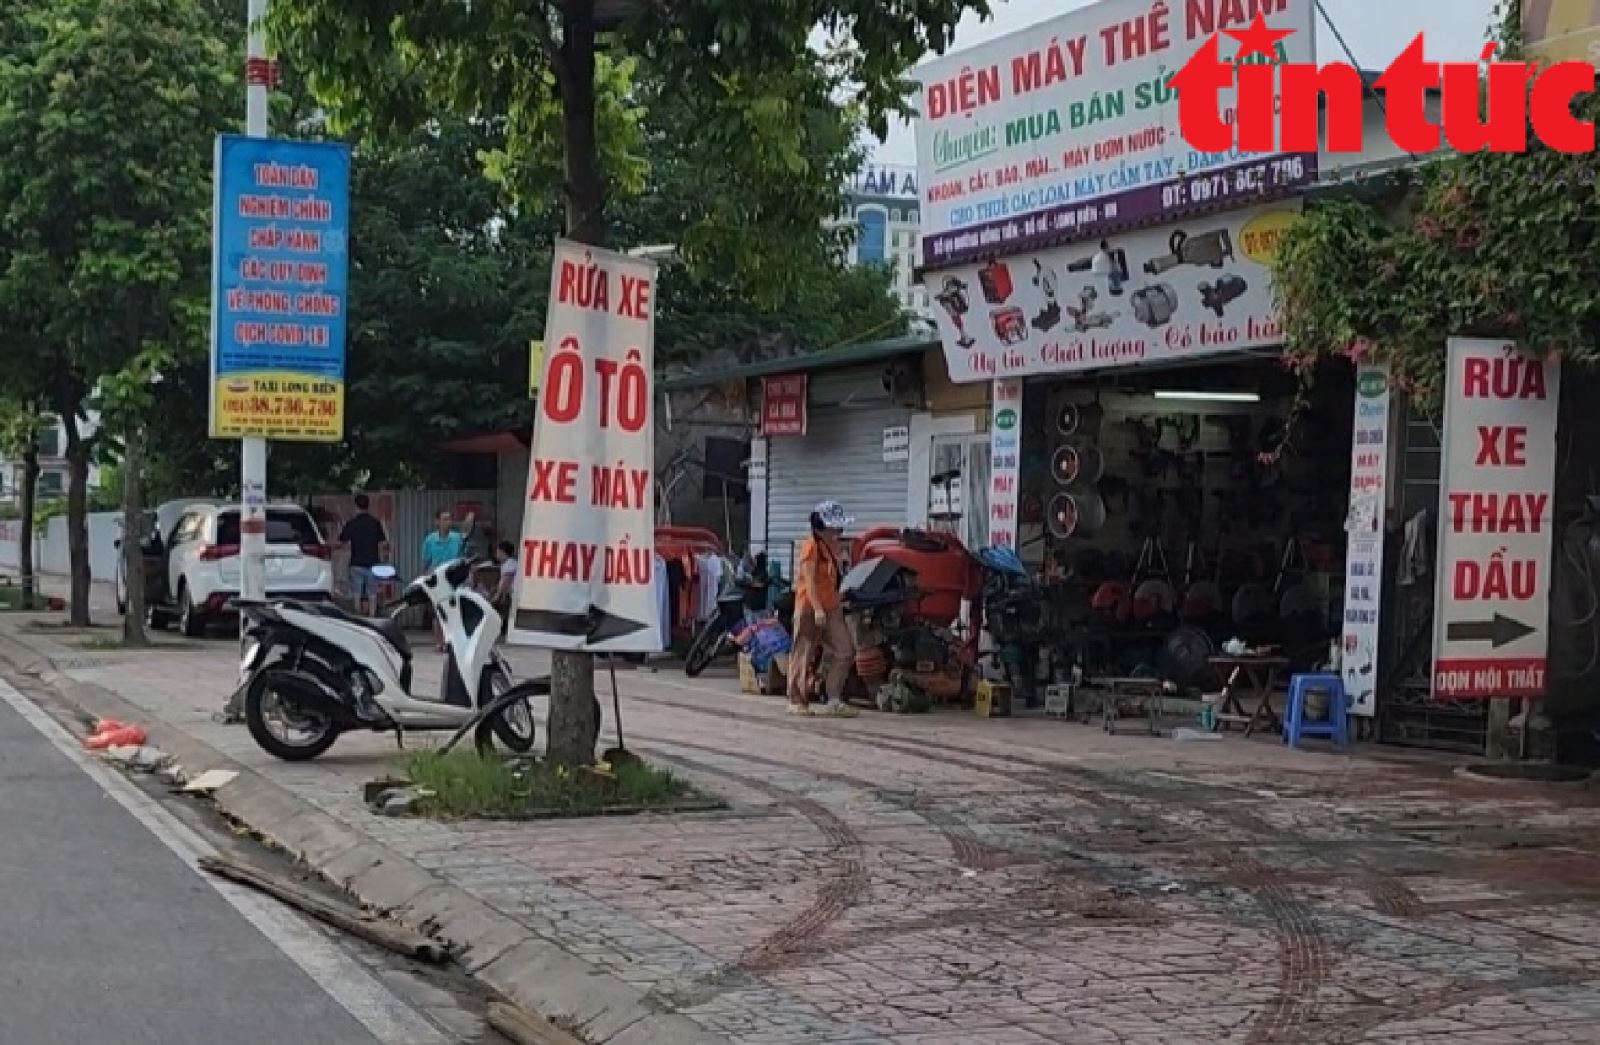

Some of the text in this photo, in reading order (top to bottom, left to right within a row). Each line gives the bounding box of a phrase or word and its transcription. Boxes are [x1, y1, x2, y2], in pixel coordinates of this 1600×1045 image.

[928, 65, 1001, 120] ĐIỆN
[1012, 35, 1087, 96] MÁY
[1006, 109, 1061, 147] MUA
[1070, 89, 1125, 129] BÁN
[1135, 65, 1179, 109] SỬ
[1144, 157, 1174, 179] TAY
[558, 251, 650, 320] RỬA XE
[281, 381, 310, 393] LONG
[544, 337, 648, 433] Ô TÔ
[1463, 344, 1547, 400] RỬA
[1475, 426, 1527, 466] XE
[530, 459, 649, 510] XE MÁY
[1449, 493, 1548, 534] THAY
[523, 539, 598, 583] THAY
